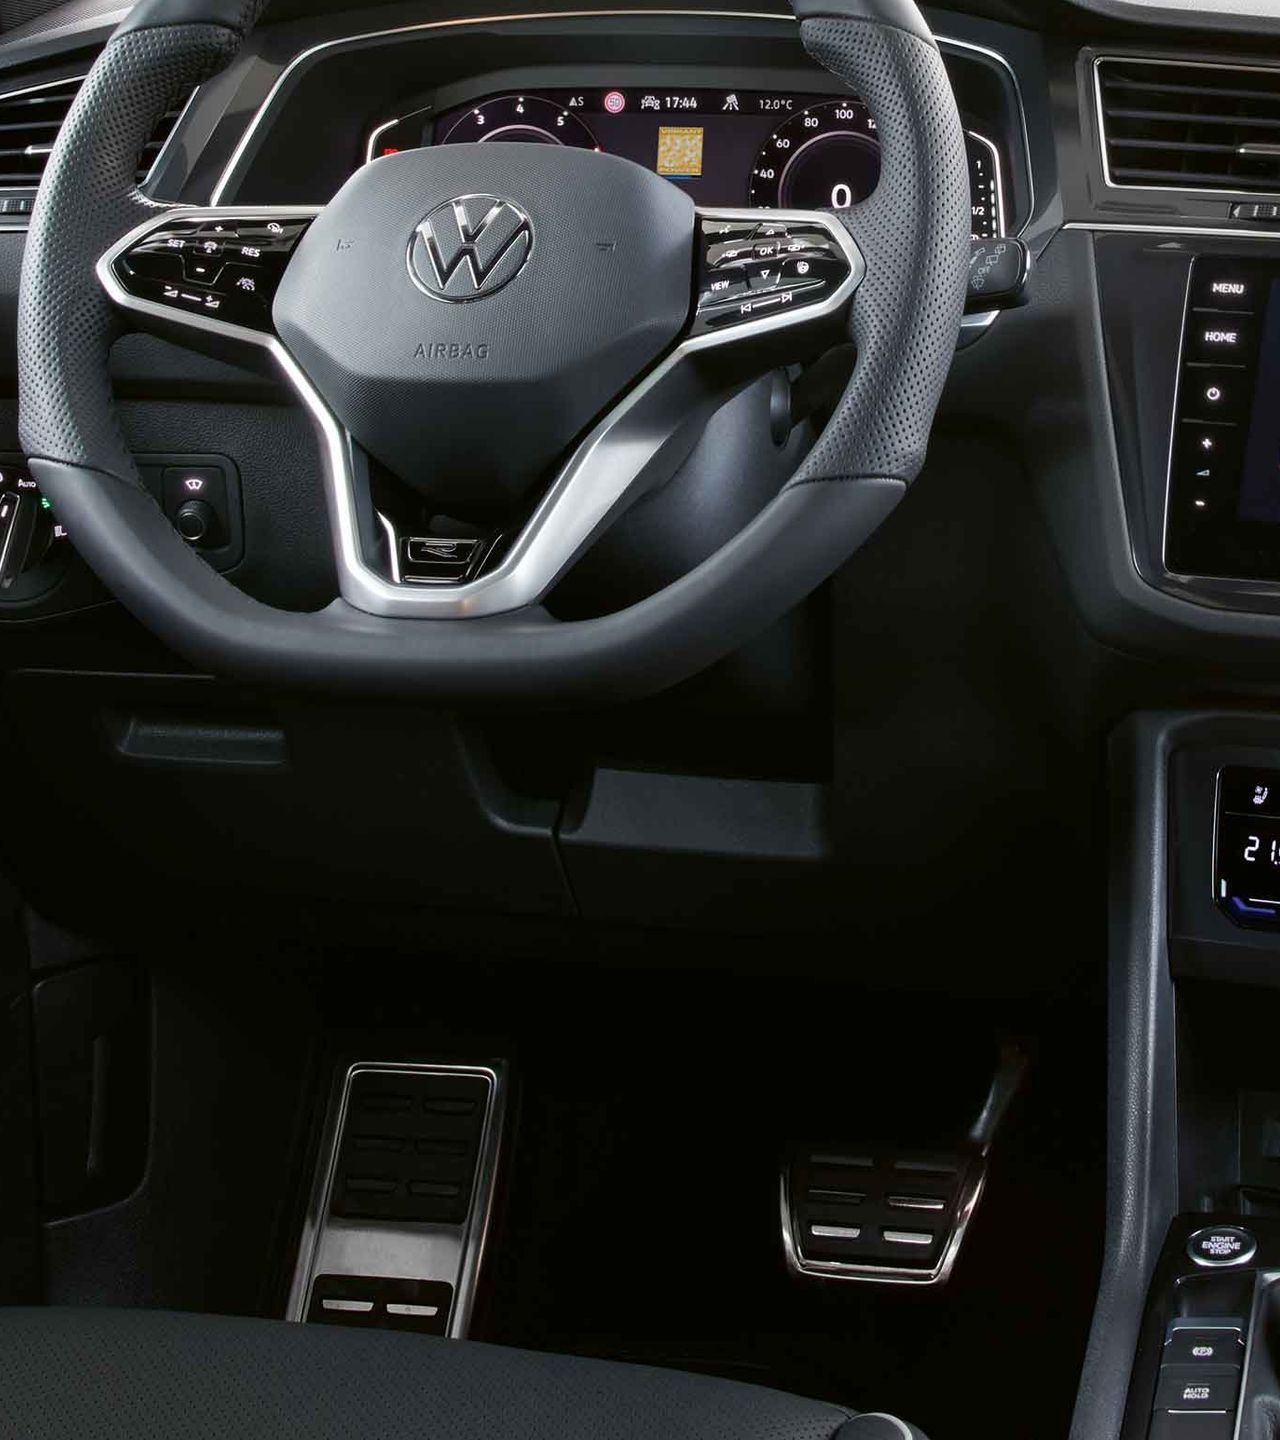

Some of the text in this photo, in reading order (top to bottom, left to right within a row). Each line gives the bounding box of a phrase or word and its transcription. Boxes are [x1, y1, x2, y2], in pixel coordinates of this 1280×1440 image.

[515, 103, 524, 114] 4
[665, 97, 698, 109] 17:44
[476, 114, 485, 125] 3
[834, 108, 854, 120] 100
[556, 115, 565, 127] 5
[804, 116, 819, 128] 80
[775, 137, 790, 150] 60
[759, 168, 775, 179] 40
[831, 183, 852, 210] 0
[971, 206, 985, 216] 1/2
[167, 238, 186, 248] SET
[241, 247, 261, 258] RES
[759, 246, 775, 256] OK
[710, 280, 730, 292] VIEW
[1212, 282, 1245, 295] MENU
[1204, 331, 1237, 344] HOME
[414, 342, 490, 360] AIRBAG
[1210, 1235, 1236, 1243] START
[1201, 1241, 1242, 1250] ENGINE
